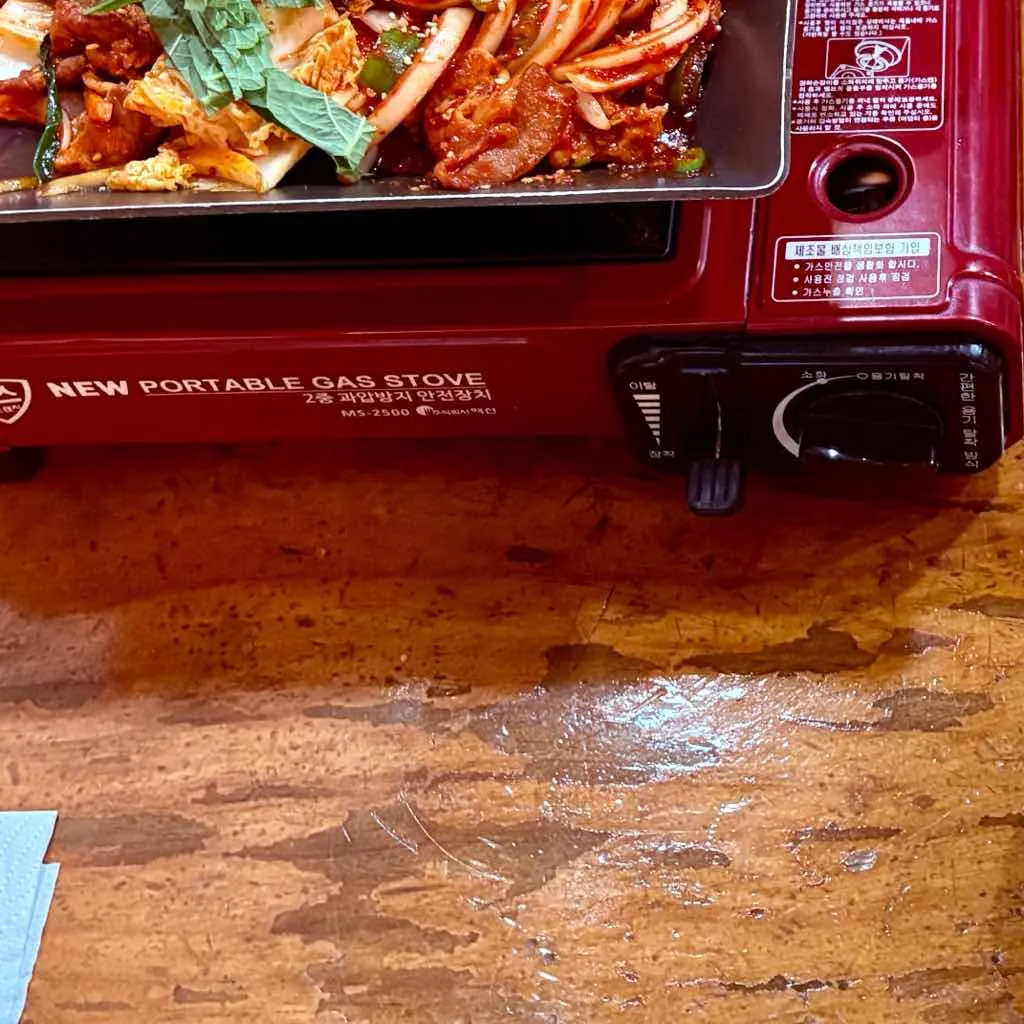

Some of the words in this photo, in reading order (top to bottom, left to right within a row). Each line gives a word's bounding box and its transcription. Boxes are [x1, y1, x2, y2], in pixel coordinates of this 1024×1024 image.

[47, 380, 129, 397] NEW
[138, 377, 305, 393] PORTABLE
[312, 375, 376, 389] GAS
[384, 373, 486, 387] STOVE
[337, 391, 413, 403] 과압방지
[416, 389, 492, 402] 안전장치
[341, 409, 410, 417] MS-2500
